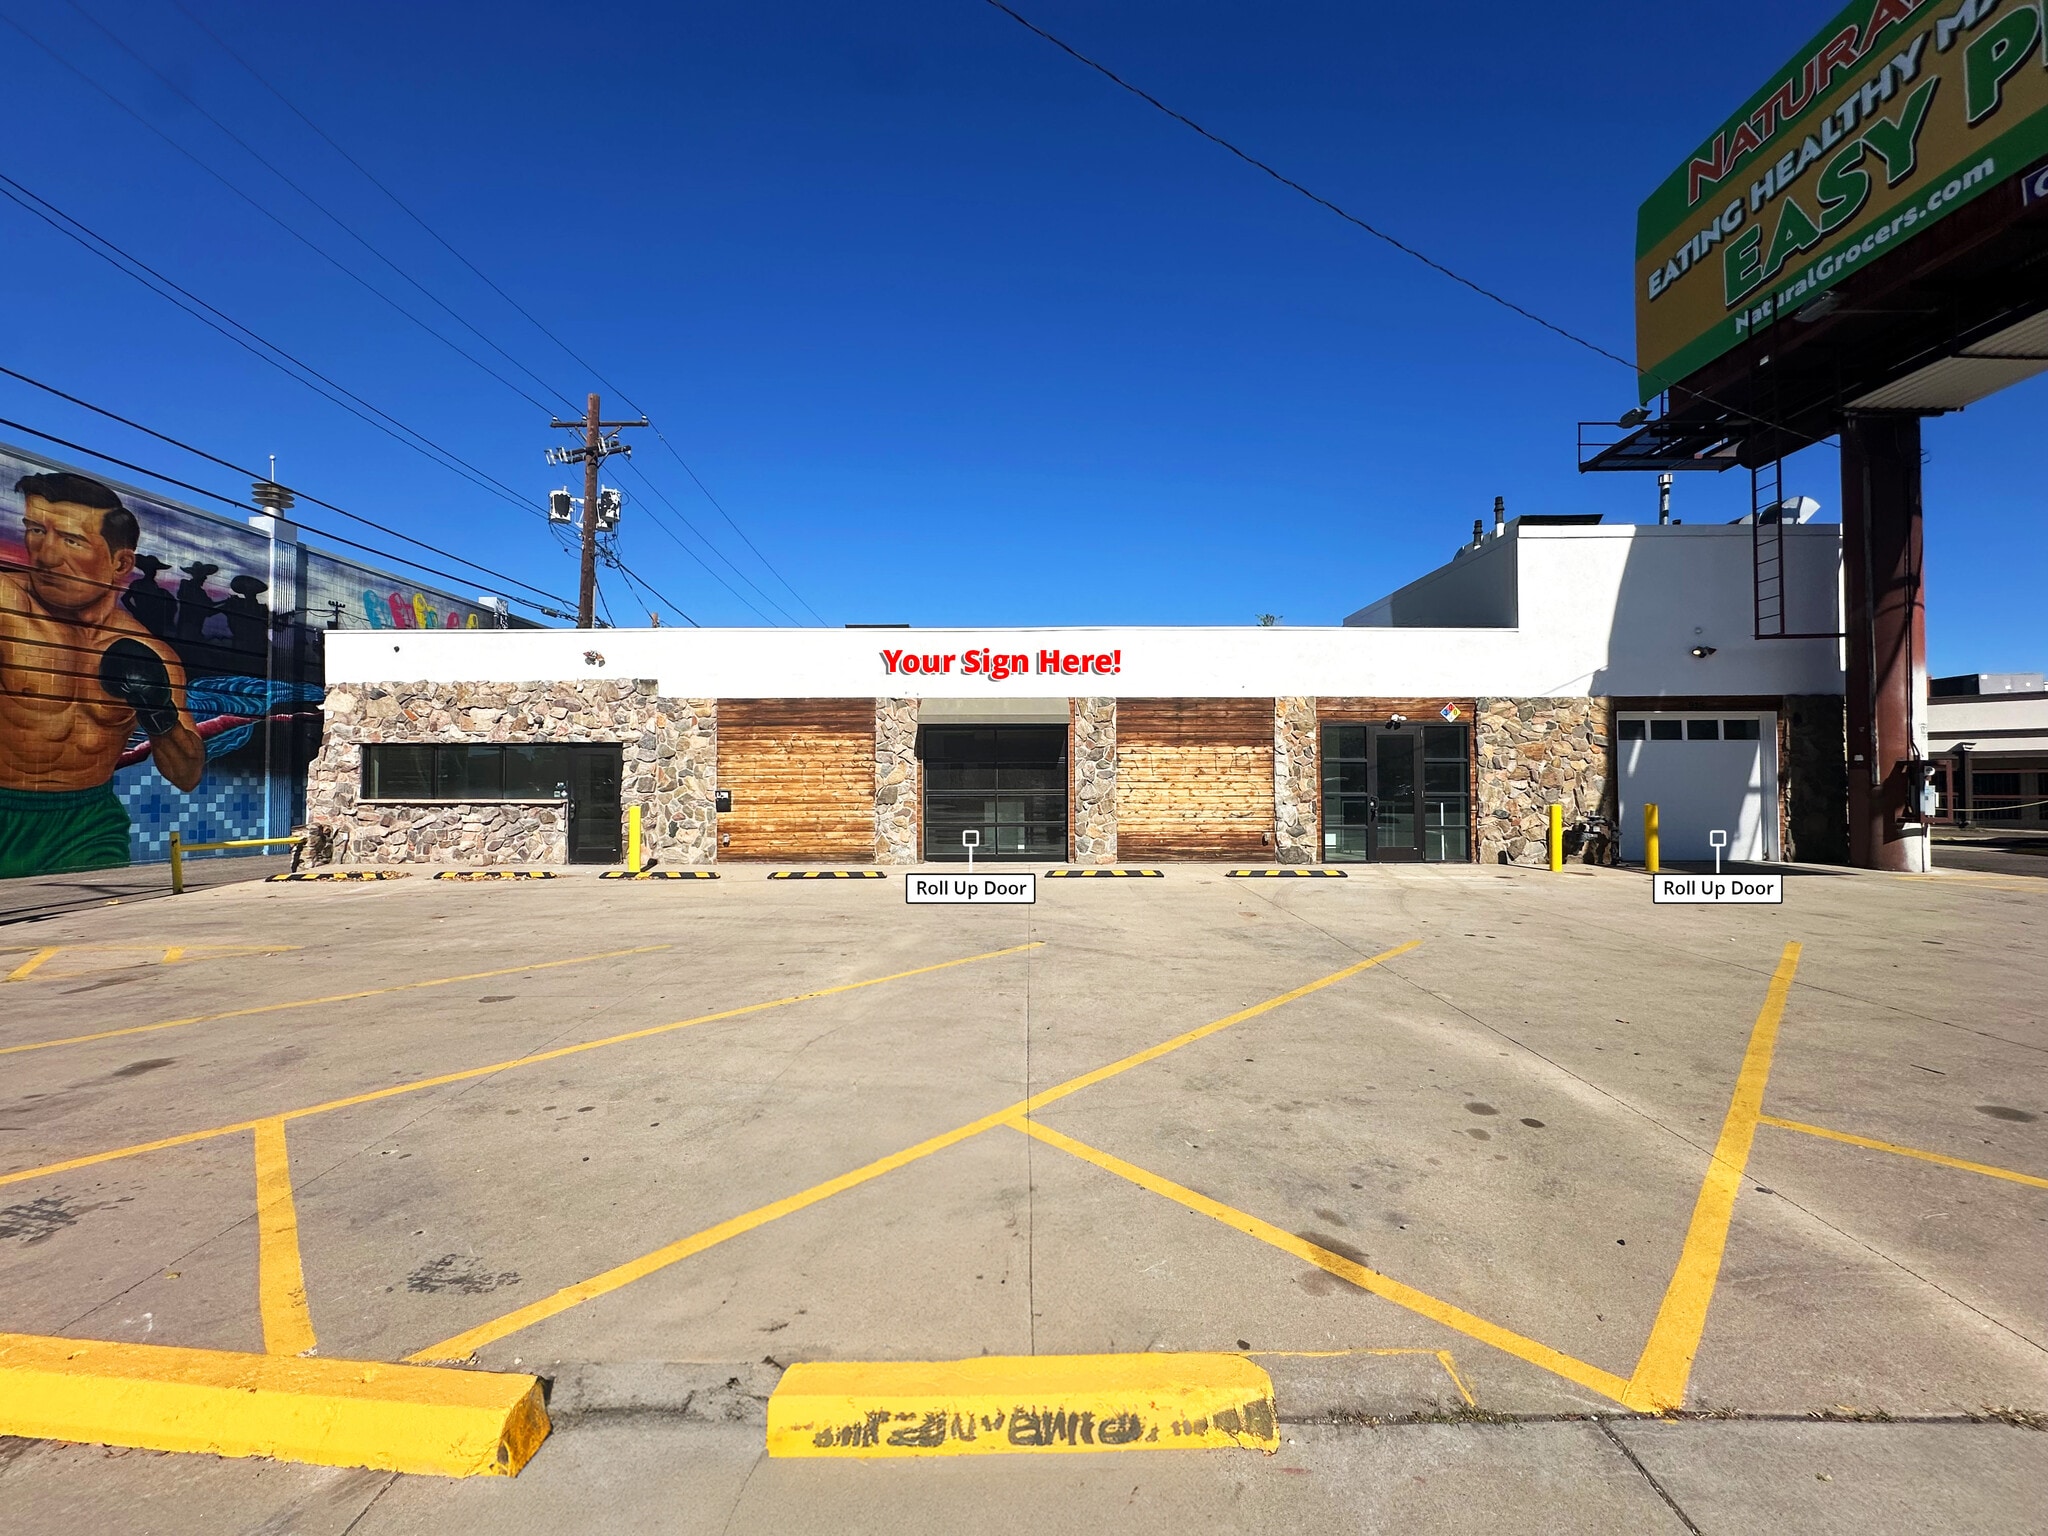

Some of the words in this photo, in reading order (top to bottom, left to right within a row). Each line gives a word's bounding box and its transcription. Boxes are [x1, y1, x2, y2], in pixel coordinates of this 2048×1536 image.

[1648, 197, 1745, 301] EATING
[1750, 30, 1929, 213] HEALTHY
[1723, 74, 1940, 308] EASY
[1963, 0, 2048, 126] P
